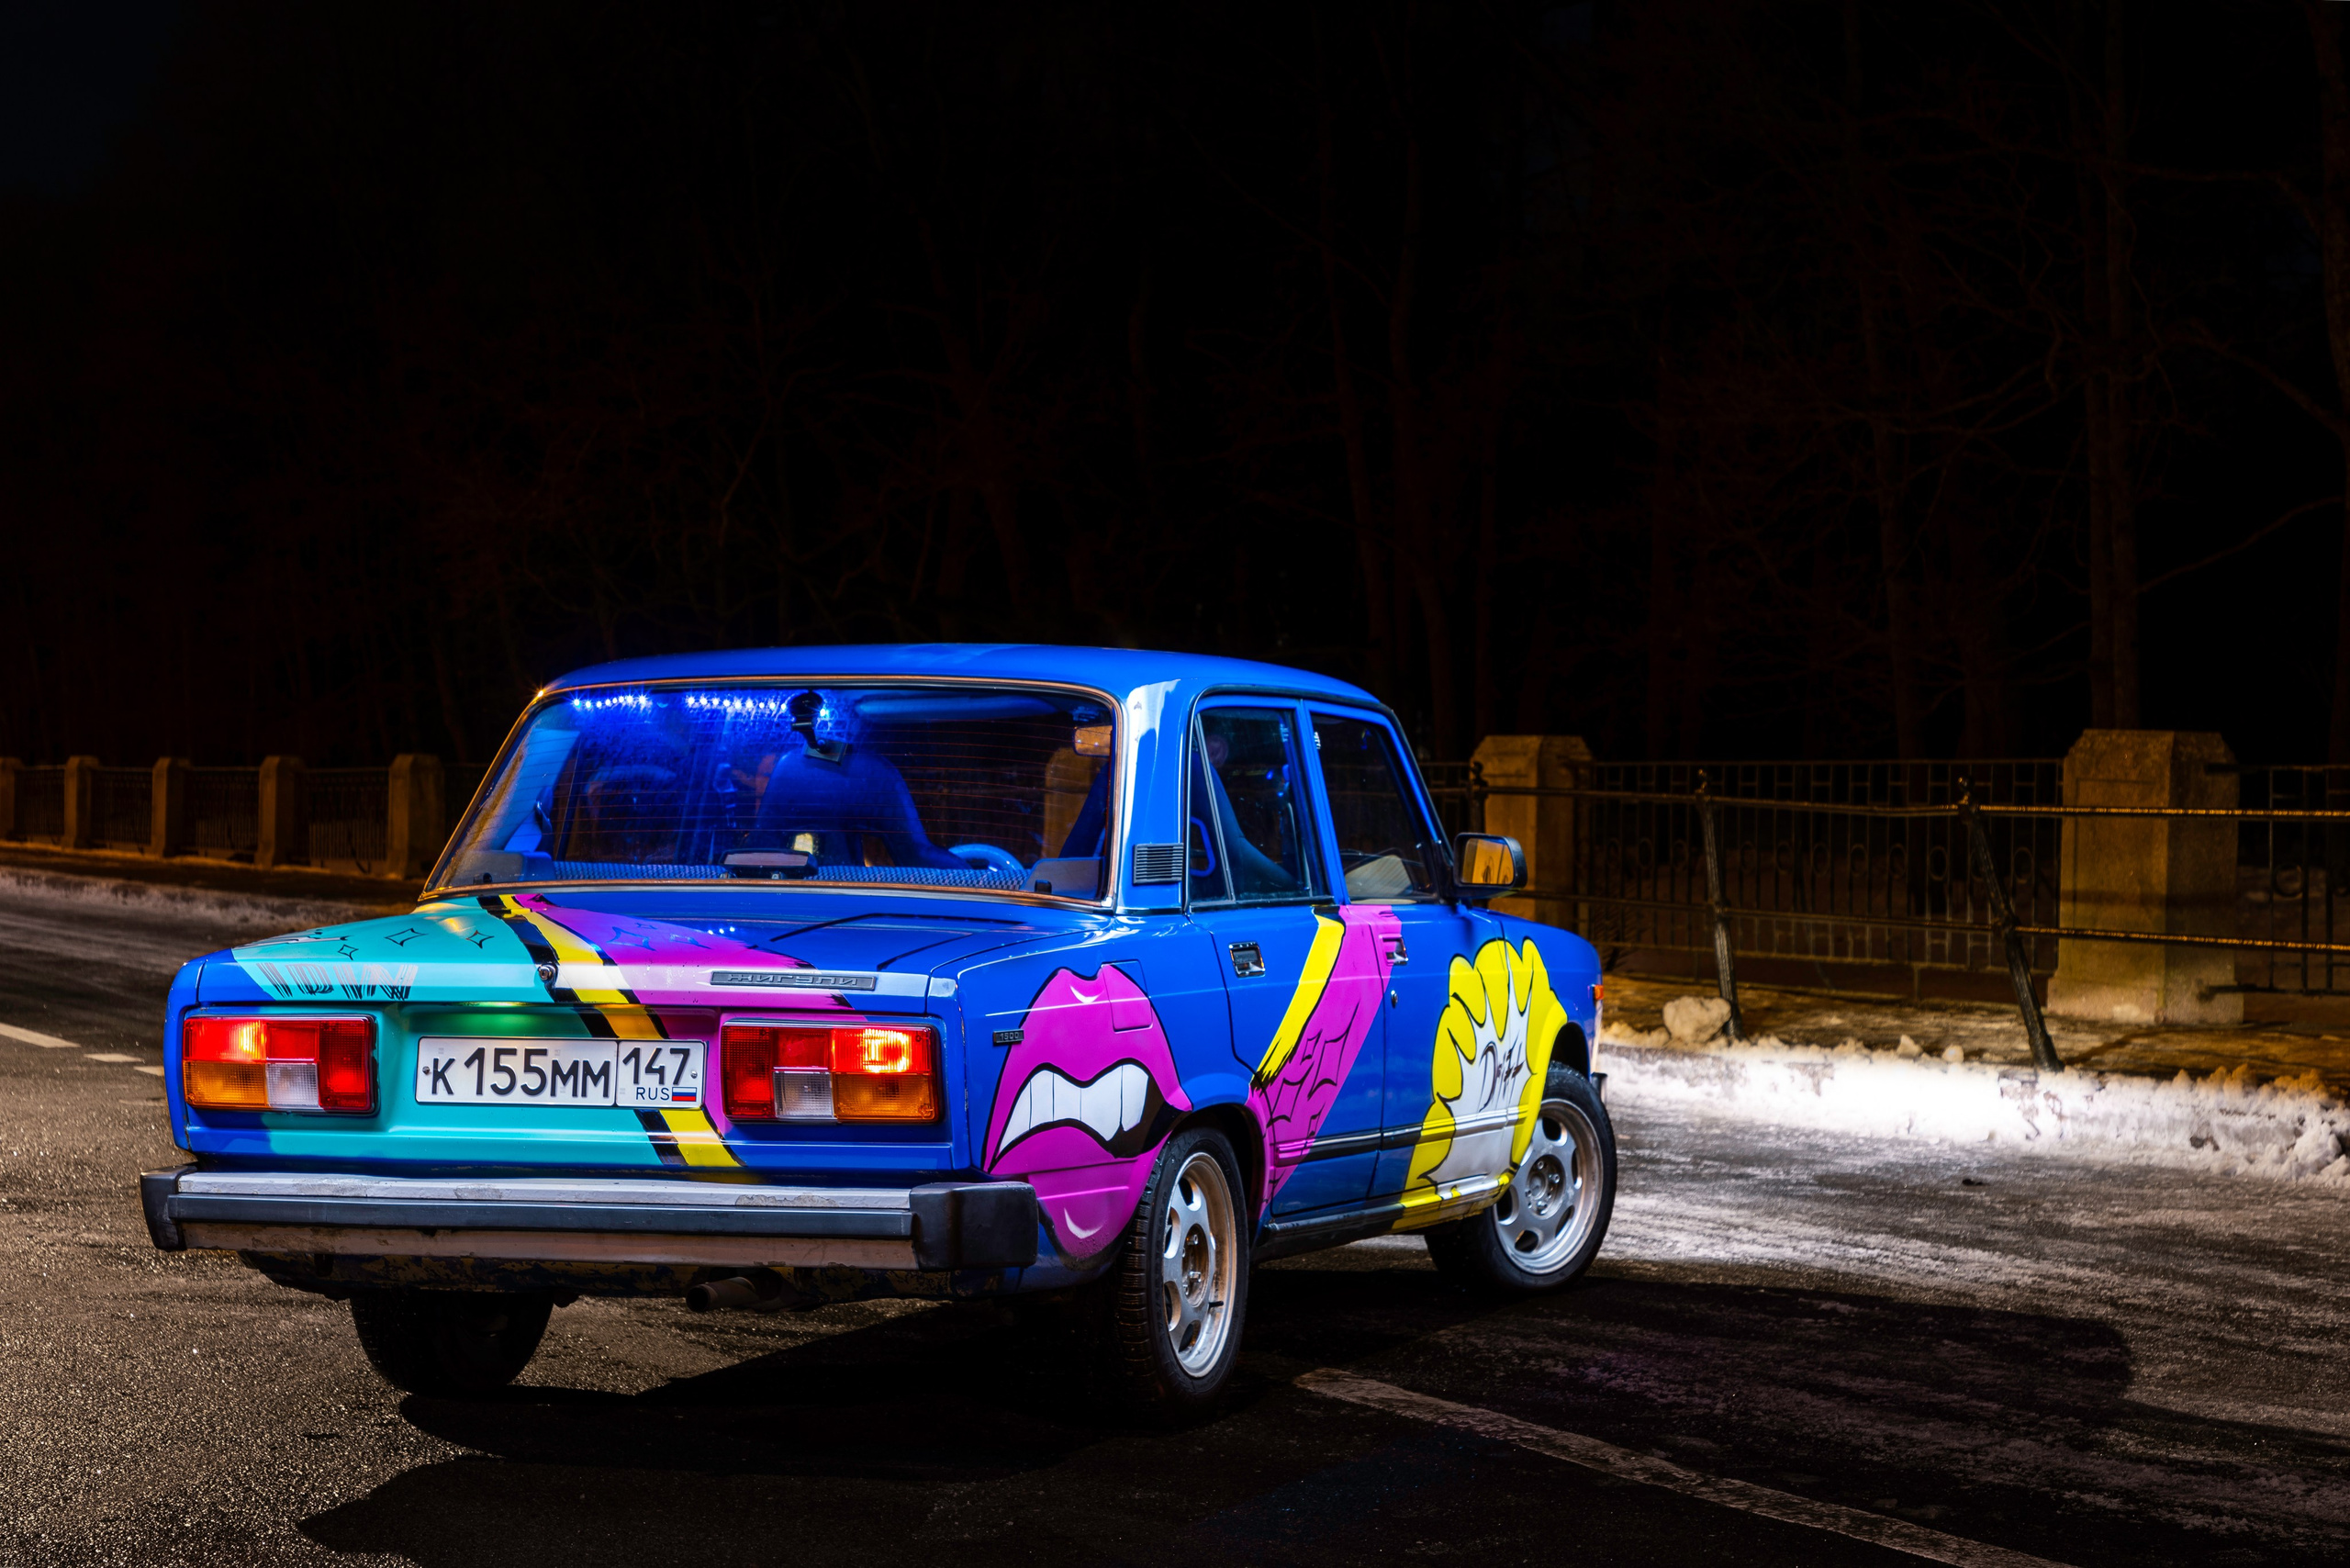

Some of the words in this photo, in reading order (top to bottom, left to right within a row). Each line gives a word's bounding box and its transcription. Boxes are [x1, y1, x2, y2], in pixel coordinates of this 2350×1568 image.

[726, 973, 858, 987] ЖИГУЛИ
[1000, 1031, 1020, 1042] 1500
[622, 1047, 690, 1086] 147
[635, 1086, 670, 1101] RUS
